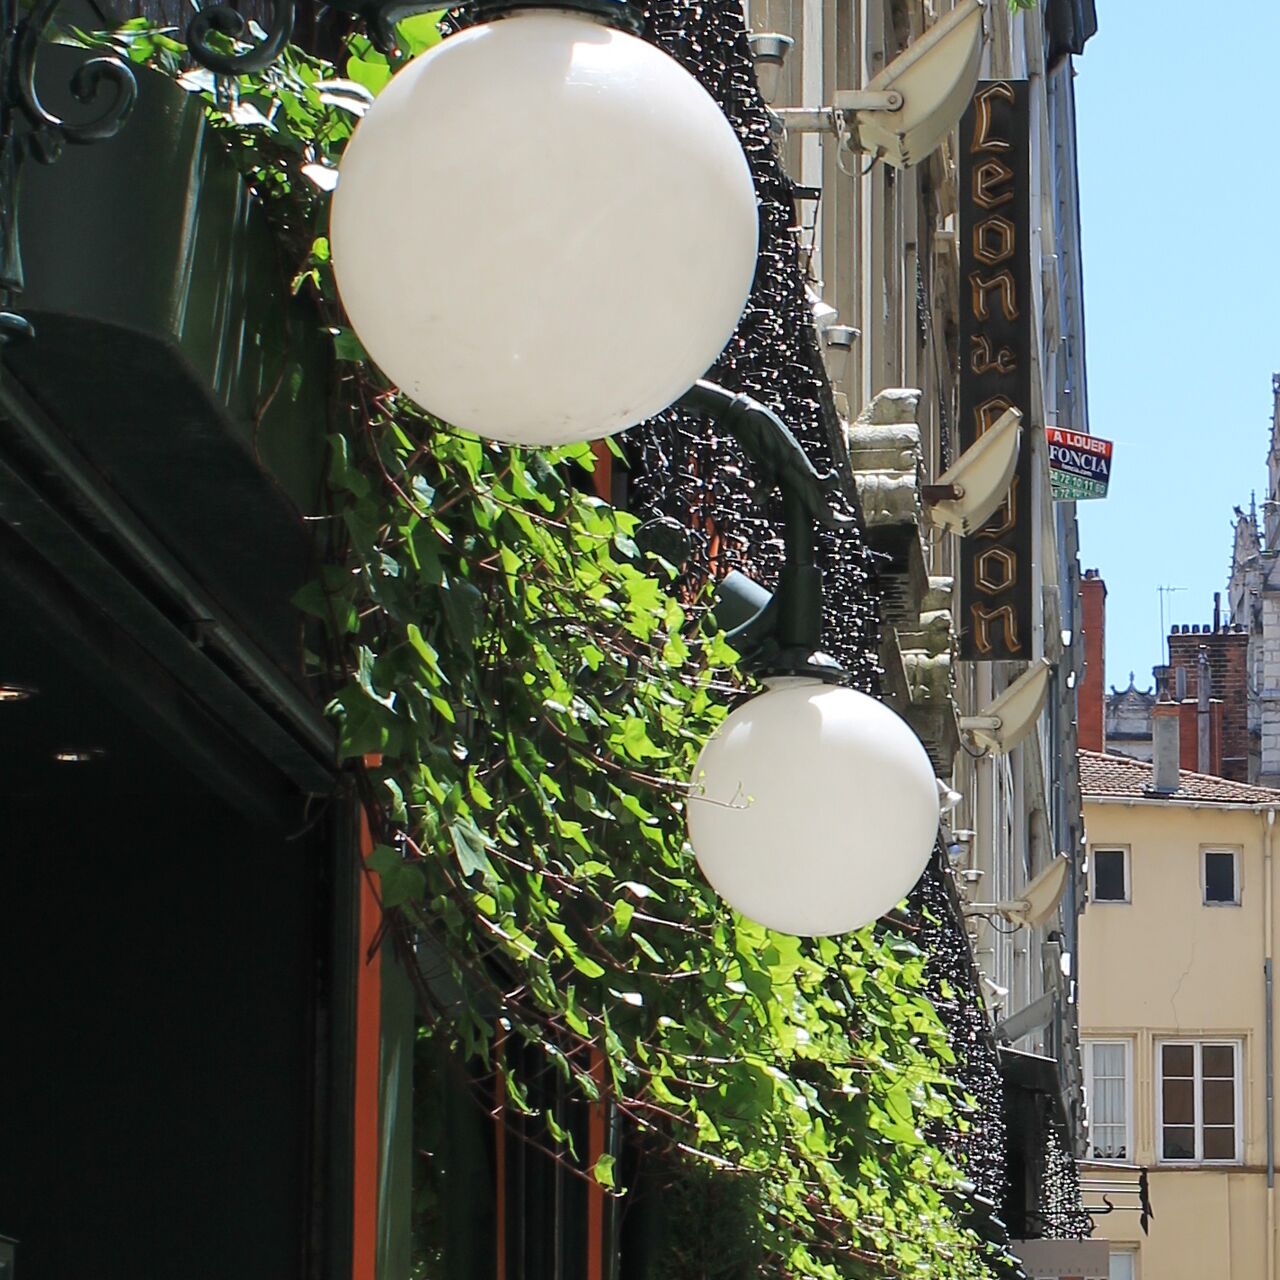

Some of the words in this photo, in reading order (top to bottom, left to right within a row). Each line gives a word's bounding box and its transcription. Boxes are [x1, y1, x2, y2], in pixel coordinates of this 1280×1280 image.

[971, 81, 1019, 321] Leon
[971, 334, 1017, 374] de
[1053, 431, 1063, 443] A
[1066, 434, 1106, 454] LOUER
[1049, 445, 1108, 474] FONCIA
[1060, 474, 1070, 484] 72
